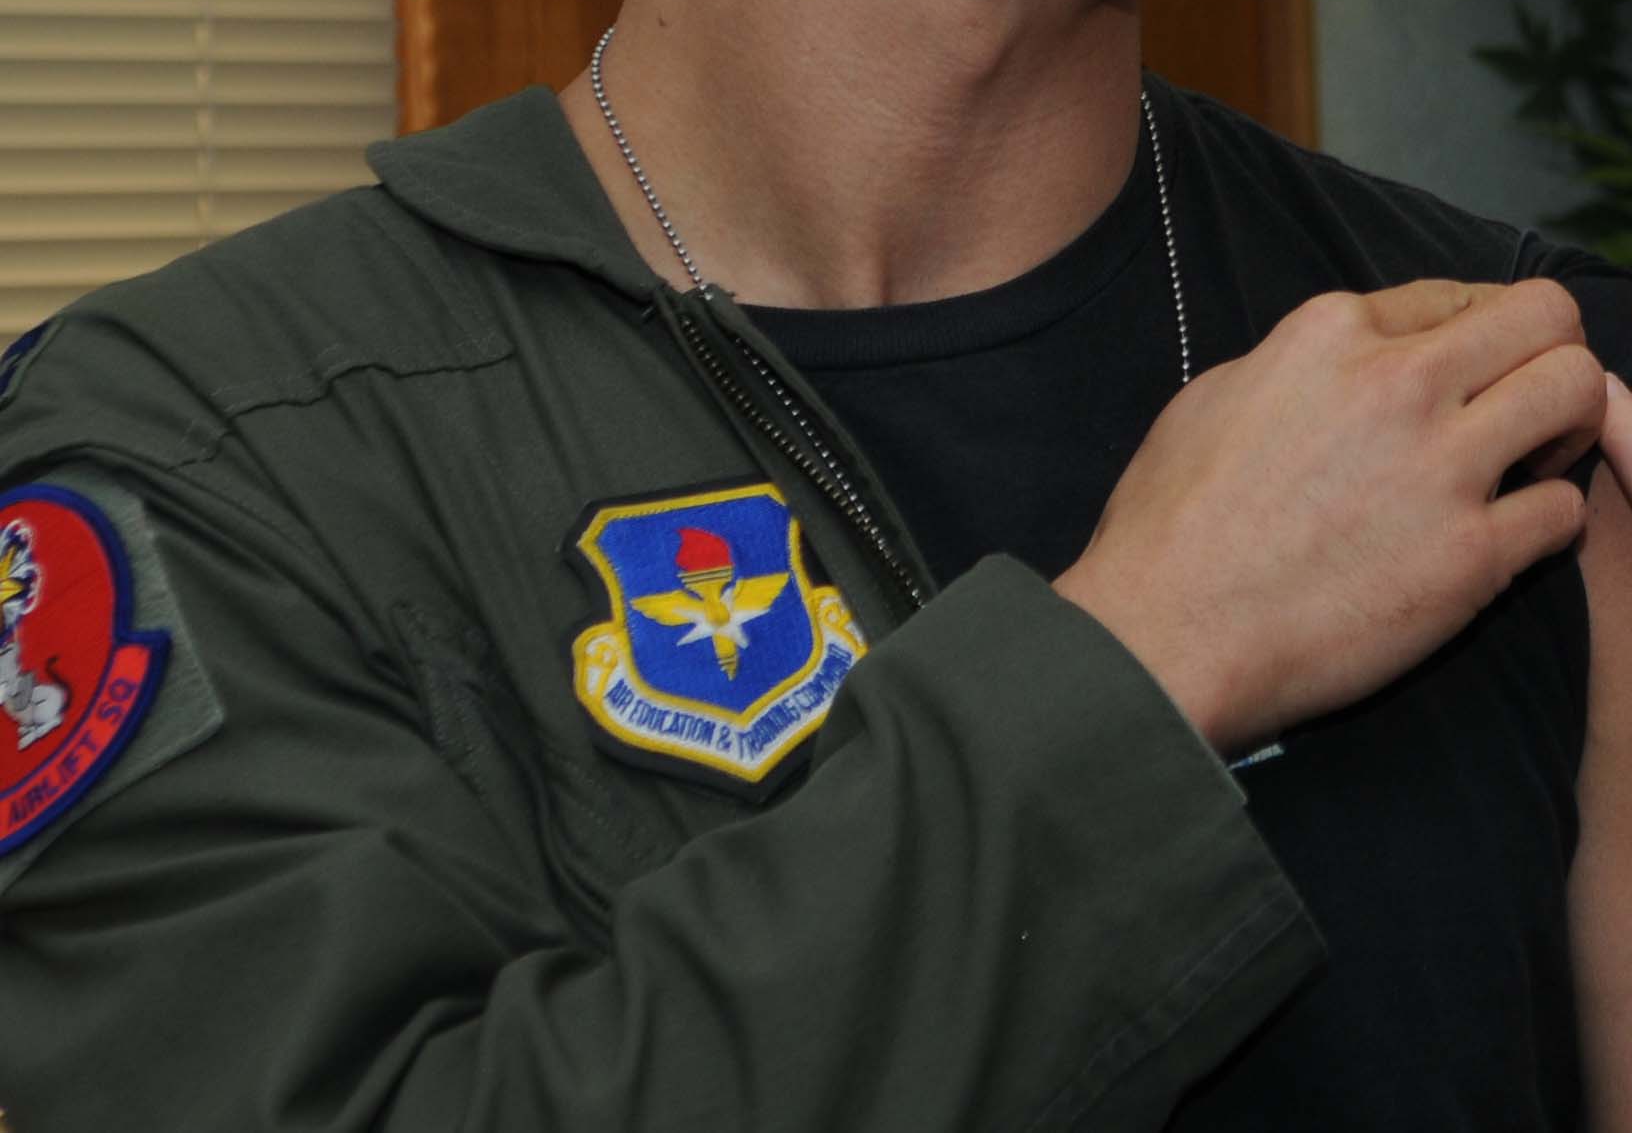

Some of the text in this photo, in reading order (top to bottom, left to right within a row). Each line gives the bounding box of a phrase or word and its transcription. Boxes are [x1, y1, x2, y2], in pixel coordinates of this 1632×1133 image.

[8, 677, 137, 826] AIRLIFT SQ
[604, 677, 635, 715] AIR
[627, 699, 717, 745] EDUCATION
[715, 723, 733, 751] &
[735, 698, 800, 760] TRAINING
